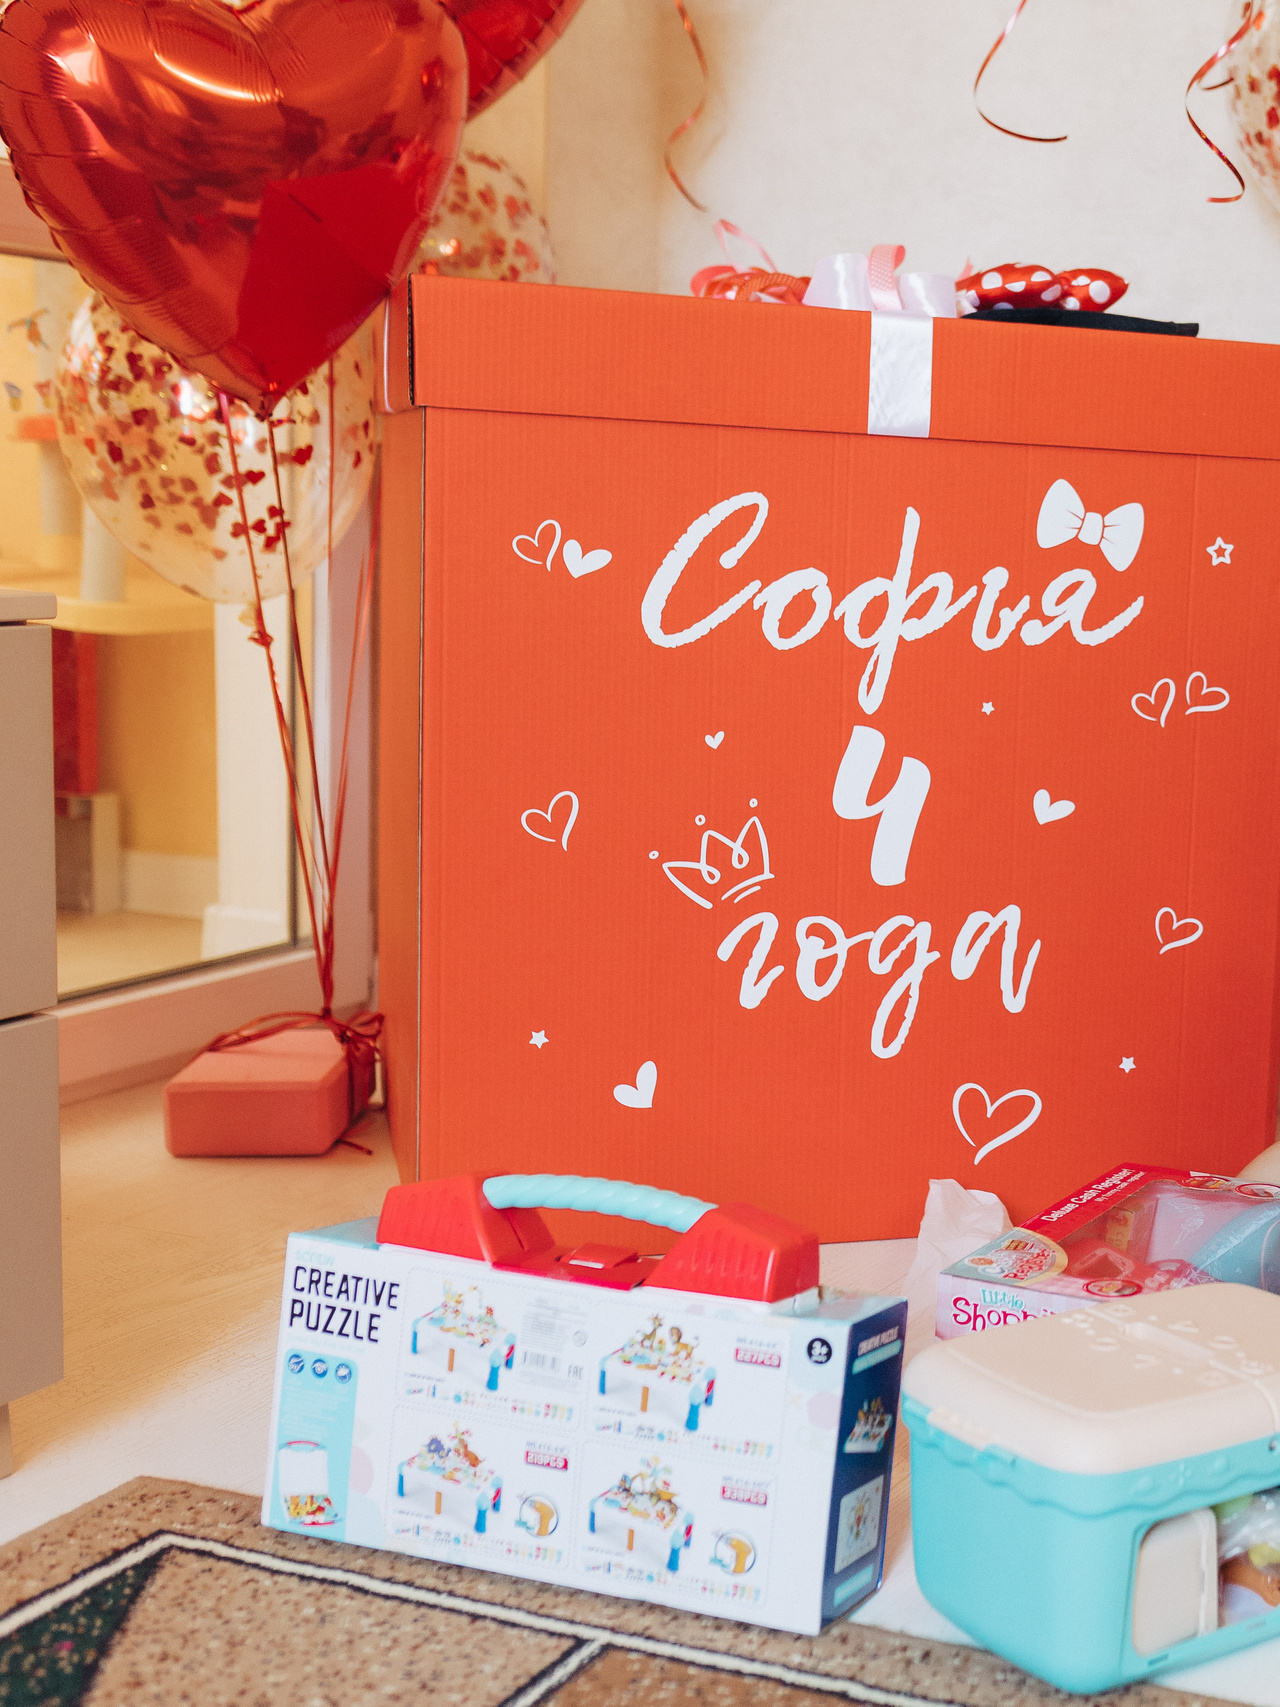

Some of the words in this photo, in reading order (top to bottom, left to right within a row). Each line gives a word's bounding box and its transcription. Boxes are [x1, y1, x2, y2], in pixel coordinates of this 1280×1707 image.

[641, 491, 1145, 715] Софья
[832, 725, 932, 886] 4
[717, 904, 1042, 1059] года
[1041, 1202, 1079, 1222] Deluxe
[1070, 1189, 1102, 1204] Cash
[288, 1298, 381, 1343] PUZZLE
[293, 1265, 400, 1310] CREATIVE
